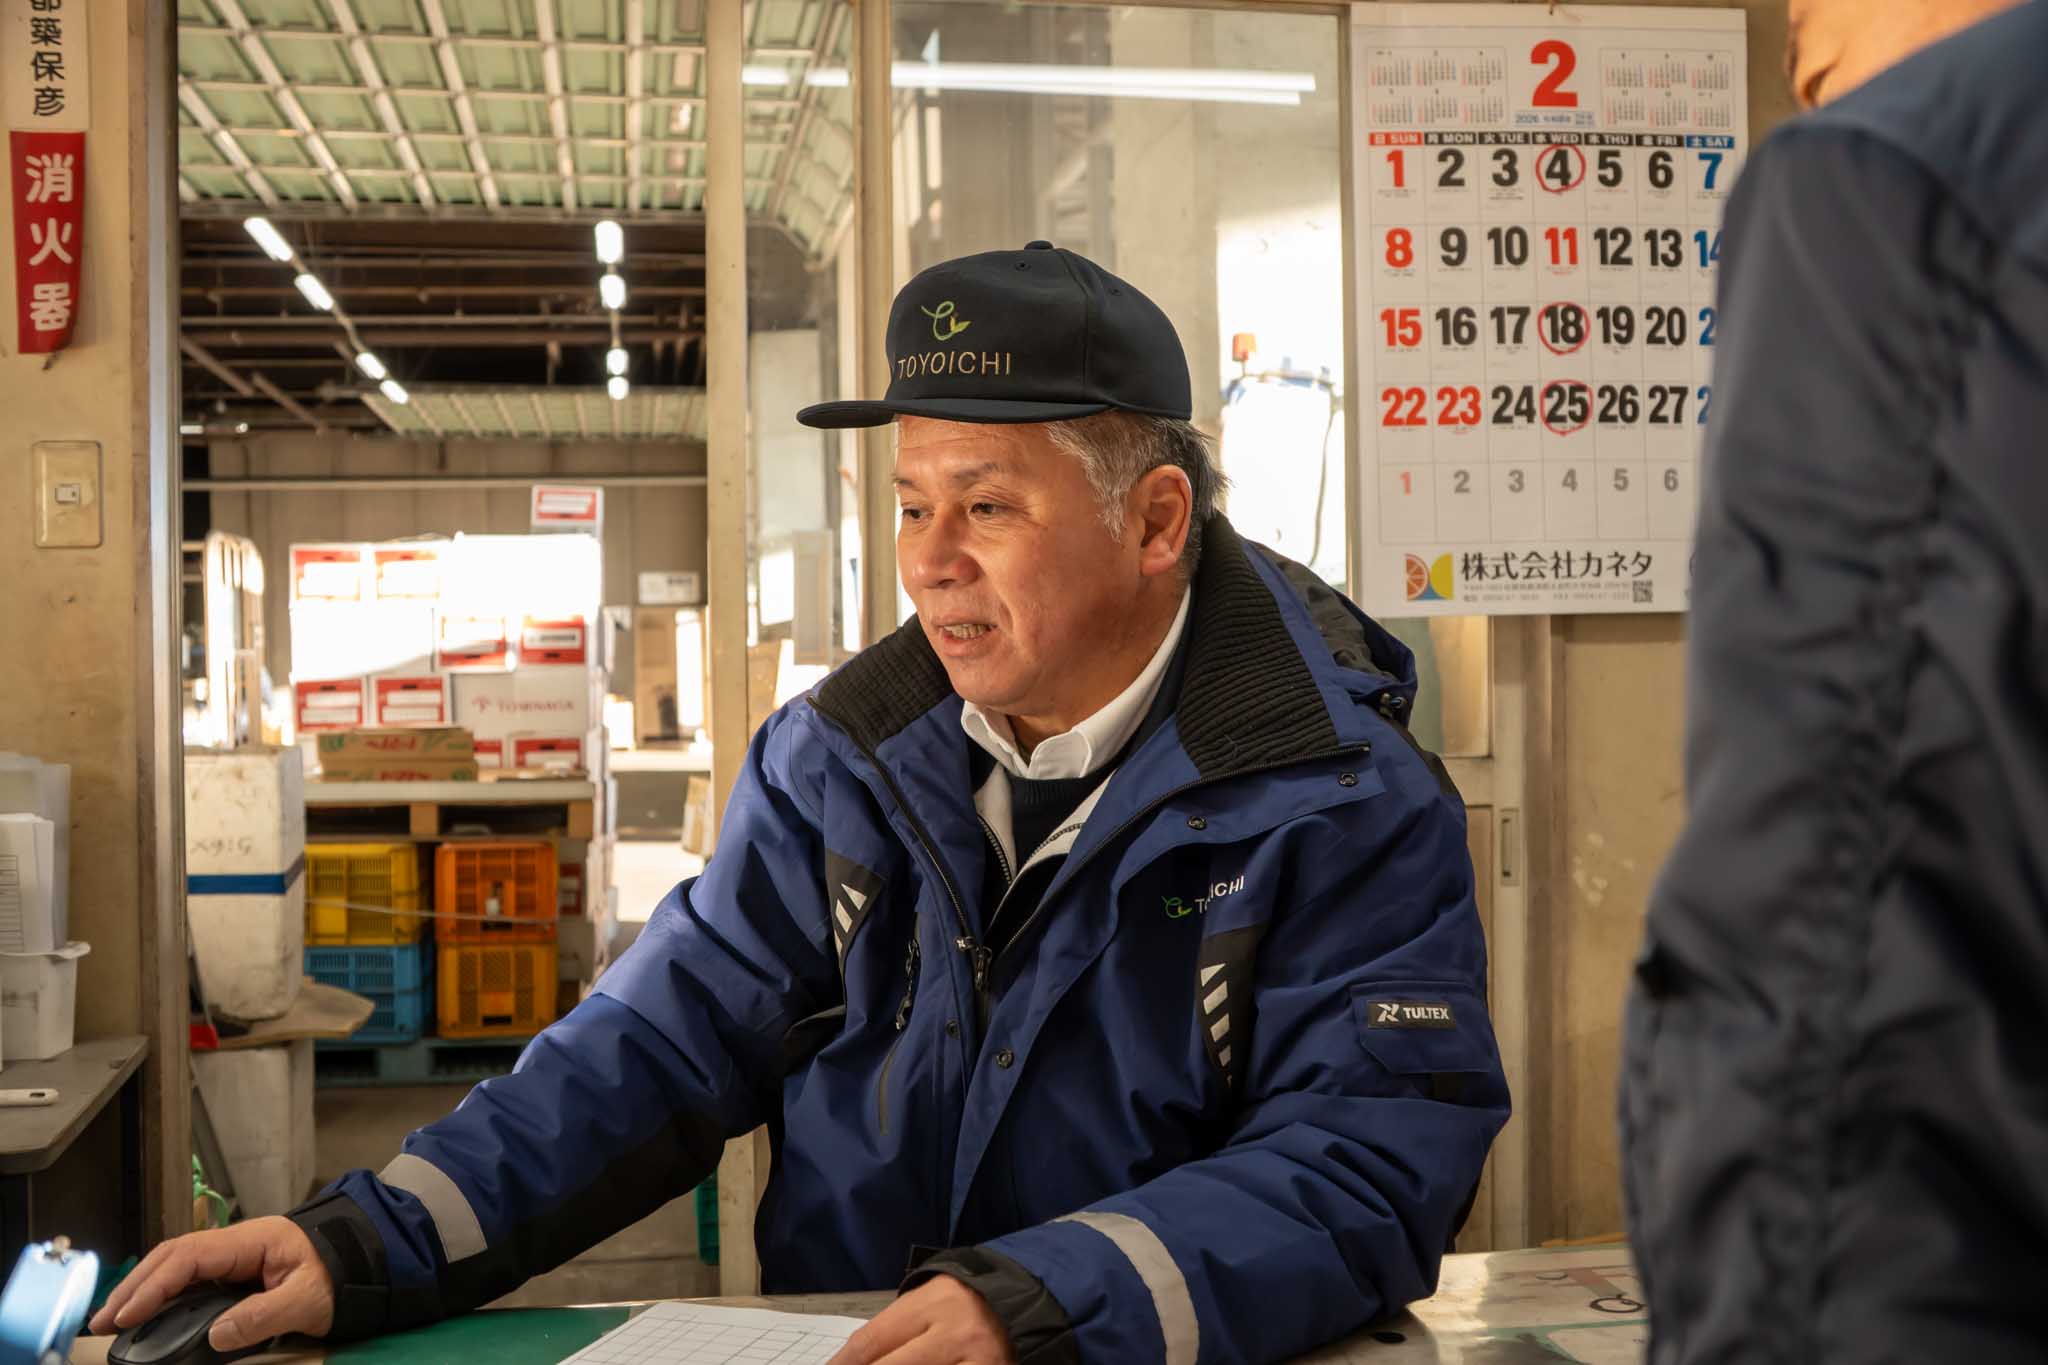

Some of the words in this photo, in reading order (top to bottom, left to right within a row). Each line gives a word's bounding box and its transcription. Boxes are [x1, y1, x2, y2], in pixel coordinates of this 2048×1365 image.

[1530, 39, 1579, 108] 2
[1375, 133, 1386, 144] 日
[1391, 133, 1419, 144] SUN
[1428, 133, 1440, 144] 月
[1443, 133, 1475, 144] MON
[1484, 133, 1496, 144] 火
[1500, 133, 1525, 144] TUE
[1551, 134, 1580, 144] WED
[1604, 135, 1630, 145] THU
[1657, 136, 1679, 147] FRI
[1706, 137, 1730, 147] SAT
[1386, 149, 1405, 188] 1
[1437, 148, 1466, 188] 2
[1492, 147, 1519, 188] 3
[1545, 148, 1572, 187] 4
[1597, 149, 1623, 188] 5
[1648, 150, 1674, 190] 6
[1698, 152, 1723, 190] 7
[26, 152, 74, 331] 消火器
[1385, 227, 1414, 269] 8
[1439, 227, 1468, 268] 9
[1487, 225, 1529, 267] 10
[1544, 226, 1579, 266] 11
[1593, 226, 1633, 266] 12
[1643, 228, 1683, 268] 13
[1380, 308, 1423, 347] 15
[1435, 306, 1478, 346] 16
[1489, 305, 1531, 345] 17
[1545, 304, 1585, 344] 18
[1596, 305, 1635, 345] 19
[1645, 306, 1687, 346] 20
[1698, 306, 1716, 346] 2
[897, 350, 1012, 381] TOYOICHI
[1381, 387, 1427, 427] 22
[1436, 385, 1482, 426] 23
[1491, 385, 1537, 425] 24
[1545, 384, 1590, 424] 25
[1597, 384, 1640, 424] 26
[1648, 385, 1689, 425] 27
[1696, 385, 1712, 425] 2
[1399, 471, 1412, 496] 1
[1453, 469, 1471, 494] 2
[1507, 468, 1525, 494] 3
[1561, 468, 1579, 492] 4
[1613, 467, 1630, 492] 5
[1663, 467, 1679, 492] 6
[1461, 550, 1654, 583] 株式会社カネタ
[1403, 1004, 1450, 1021] TULTEX
